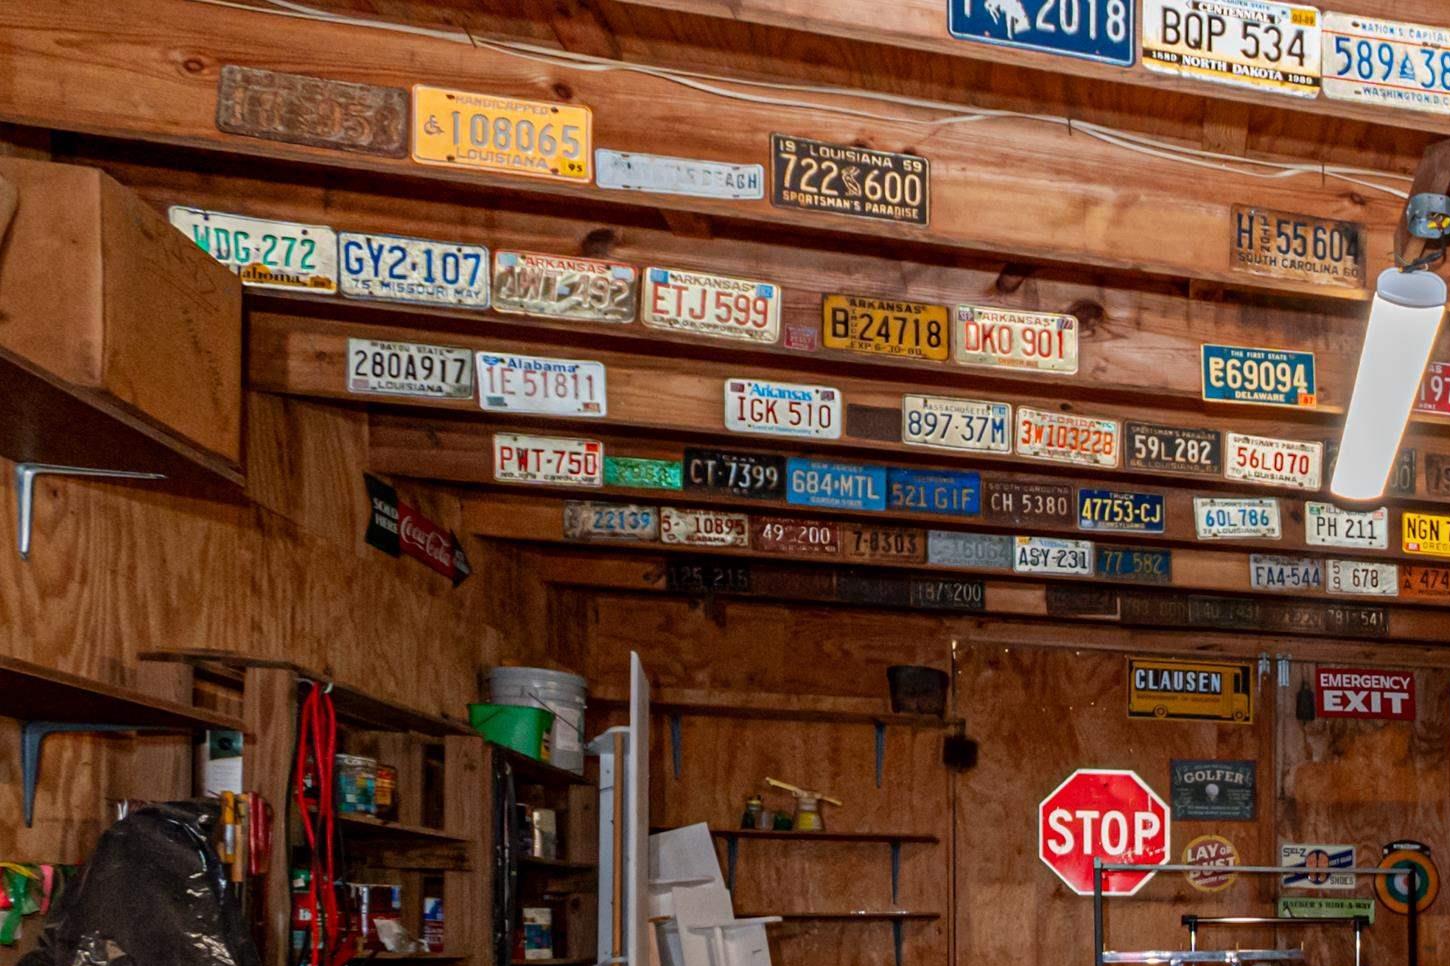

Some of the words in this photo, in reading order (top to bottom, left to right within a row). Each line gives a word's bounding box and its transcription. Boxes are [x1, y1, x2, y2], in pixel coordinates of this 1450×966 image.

[1197, 2, 1270, 24] CENTENNIAL
[1161, 6, 1226, 52] BQP
[1241, 21, 1305, 67] 534
[1361, 22, 1405, 37] NATION'S
[1408, 27, 1450, 44] CAPITAL
[1181, 55, 1227, 72] NORTH
[1231, 63, 1283, 82] DAKOTA
[1335, 36, 1395, 82] 589
[1362, 85, 1430, 105] WASHINGTON
[450, 110, 582, 159] 108065
[456, 146, 549, 171] LOUISIANA
[778, 139, 797, 154] 19
[809, 143, 894, 169] LOUISIANA
[902, 159, 923, 174] 59
[567, 162, 584, 175] 95
[780, 152, 840, 197] 722
[863, 168, 922, 206] 600
[782, 189, 862, 212] SPORTSMAN'S
[864, 201, 920, 220] PARADISE
[1235, 212, 1255, 251] H
[525, 257, 608, 275] ARKANSAS
[1238, 252, 1277, 268] SOUTH
[1281, 258, 1341, 277] CAROLINA
[350, 278, 372, 291] 75
[379, 280, 447, 299] MISSOURI
[453, 286, 483, 301] MAY
[569, 273, 631, 311] 492
[675, 273, 751, 293] ARKANSAS
[651, 283, 708, 321] ETJ
[714, 290, 769, 329] 599
[850, 299, 922, 315] ARKANSAS
[831, 308, 850, 340] B
[858, 313, 943, 349] 24718
[981, 312, 1051, 328] ARKANSAS
[1021, 328, 1067, 360] 901
[1230, 349, 1244, 359] THE
[1246, 350, 1267, 360] FIRST
[1266, 351, 1289, 361] STATE
[354, 350, 468, 387] 280A917
[507, 357, 580, 374] Alabama
[377, 380, 444, 394] LOUISIANA
[522, 370, 596, 402] 51811
[749, 383, 813, 401] Arkansas
[1234, 390, 1286, 403] DELAWARE
[736, 396, 780, 426] IGK
[788, 402, 832, 429] 510
[1039, 413, 1097, 429] FLORIDA
[1133, 434, 1212, 465] 59L282
[1235, 446, 1310, 476] 56L070
[1247, 469, 1298, 484] LOUISIANA
[934, 487, 975, 510] GIF
[990, 492, 1014, 514] CH
[1022, 494, 1068, 516] 5380
[1109, 492, 1136, 501] TRUCK
[694, 517, 746, 537] 10895
[1205, 508, 1270, 528] 60L786
[1316, 516, 1338, 538] PH
[1345, 518, 1378, 541] 211
[1406, 517, 1440, 542] NGN
[1352, 568, 1380, 589] 678
[1418, 570, 1450, 590] 474
[1134, 668, 1223, 694] CLAUSEN
[1320, 673, 1411, 691] EMERGENCY
[1322, 689, 1410, 715] EXIT
[1183, 769, 1245, 786] GOLFER
[1047, 807, 1162, 857] STOP
[1187, 843, 1219, 863] LAY
[1283, 847, 1307, 858] SELZ
[1329, 876, 1355, 887] SHOES
